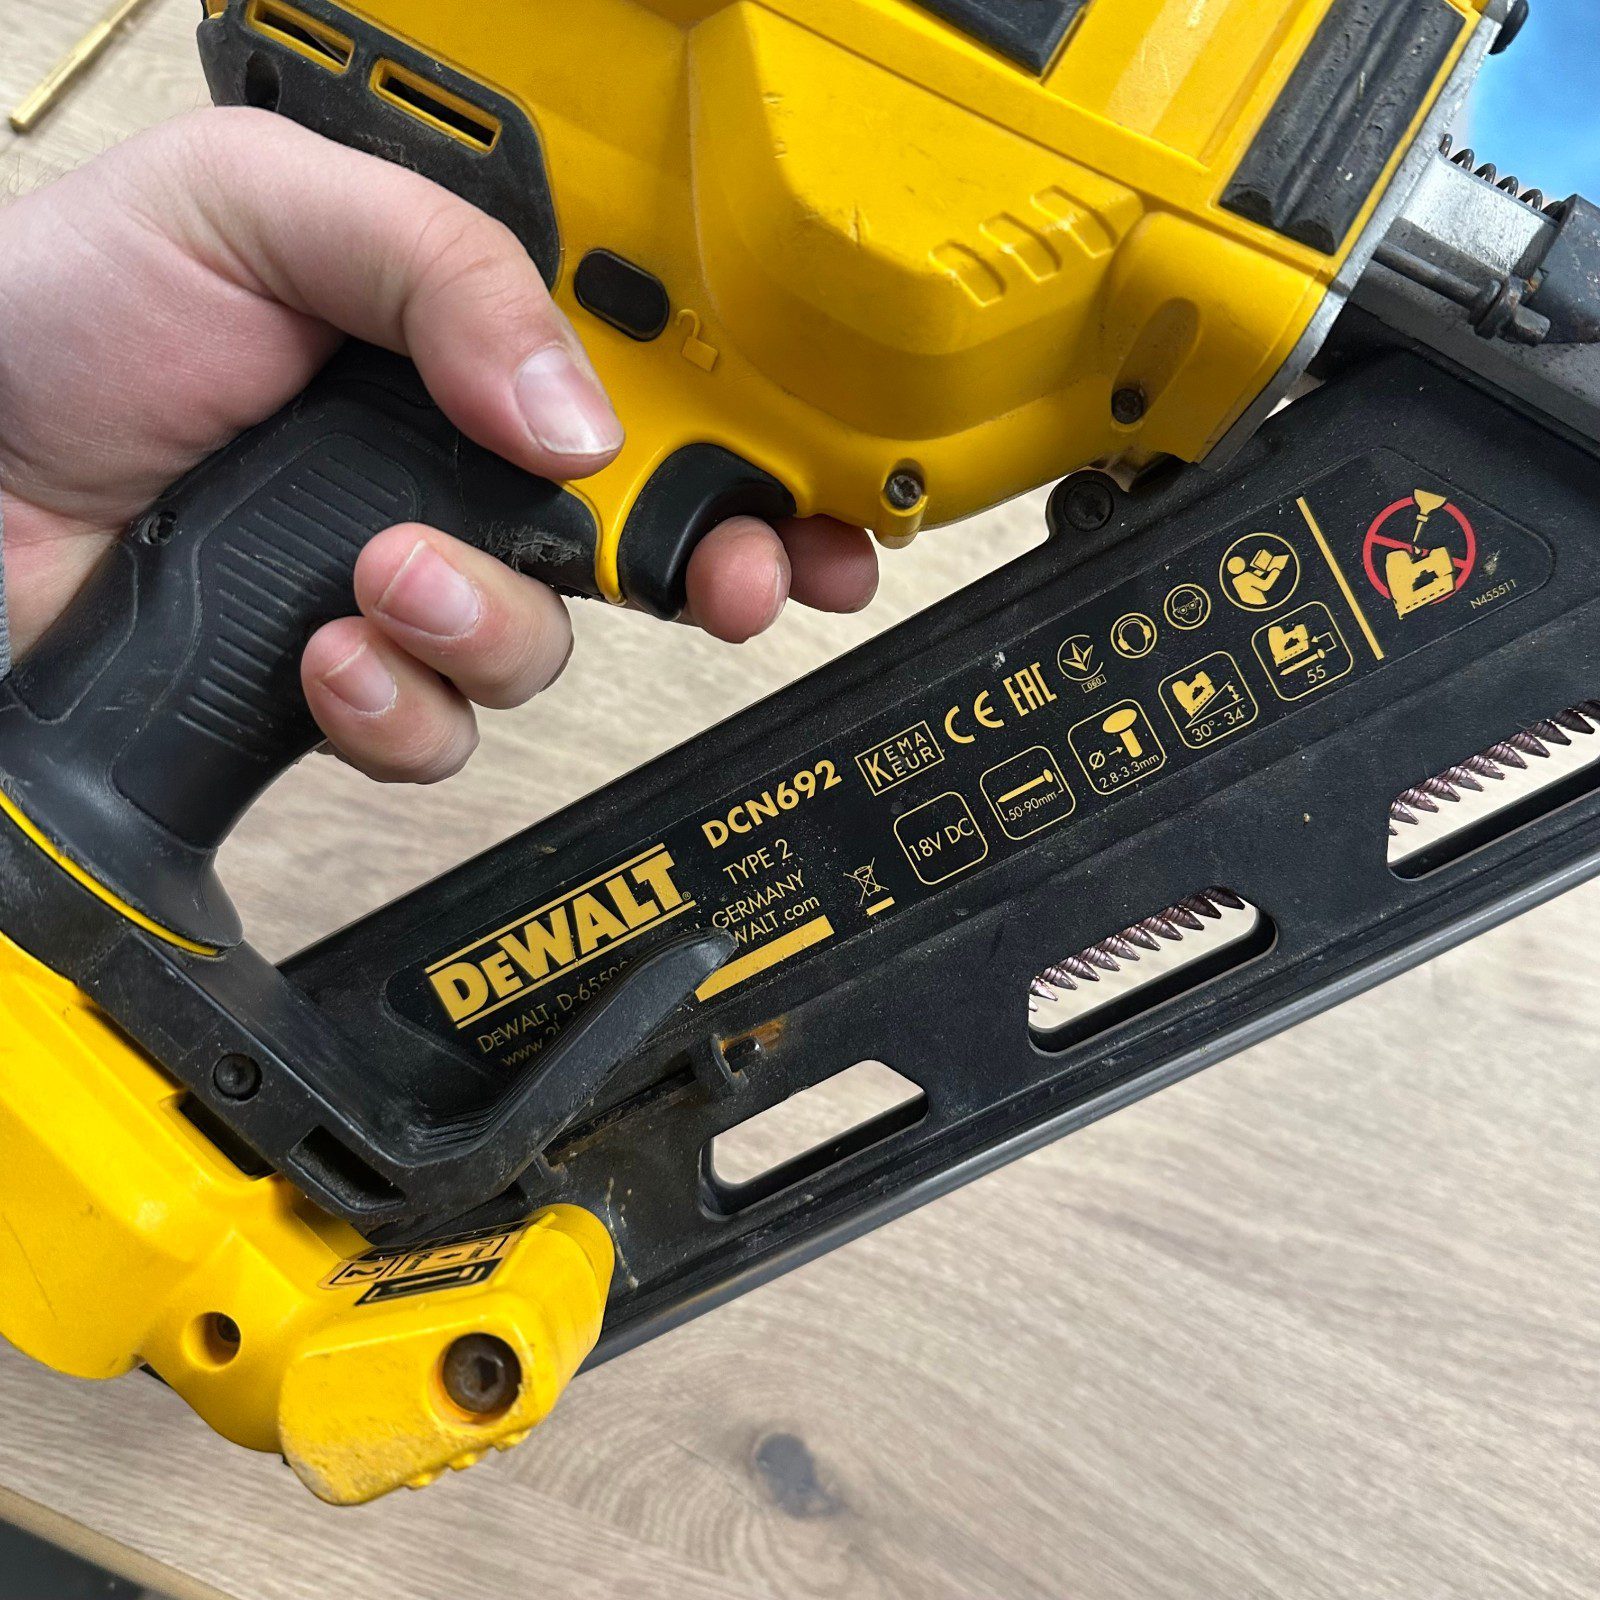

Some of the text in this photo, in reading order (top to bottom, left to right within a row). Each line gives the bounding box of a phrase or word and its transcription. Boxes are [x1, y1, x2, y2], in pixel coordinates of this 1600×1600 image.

[1470, 579, 1517, 610] N455511
[1306, 666, 1327, 684] 55
[944, 689, 1005, 744] CE
[1098, 753, 1160, 789] 2.8-3.3mm
[701, 759, 843, 849] DCN692
[1008, 790, 1057, 822] 50-90mm
[722, 838, 793, 884] TYPE 2
[908, 817, 975, 862] 18V DC
[428, 850, 684, 1022] DEWALT
[476, 1002, 558, 1053] DEWALT,
[712, 869, 804, 929] GERMANY
